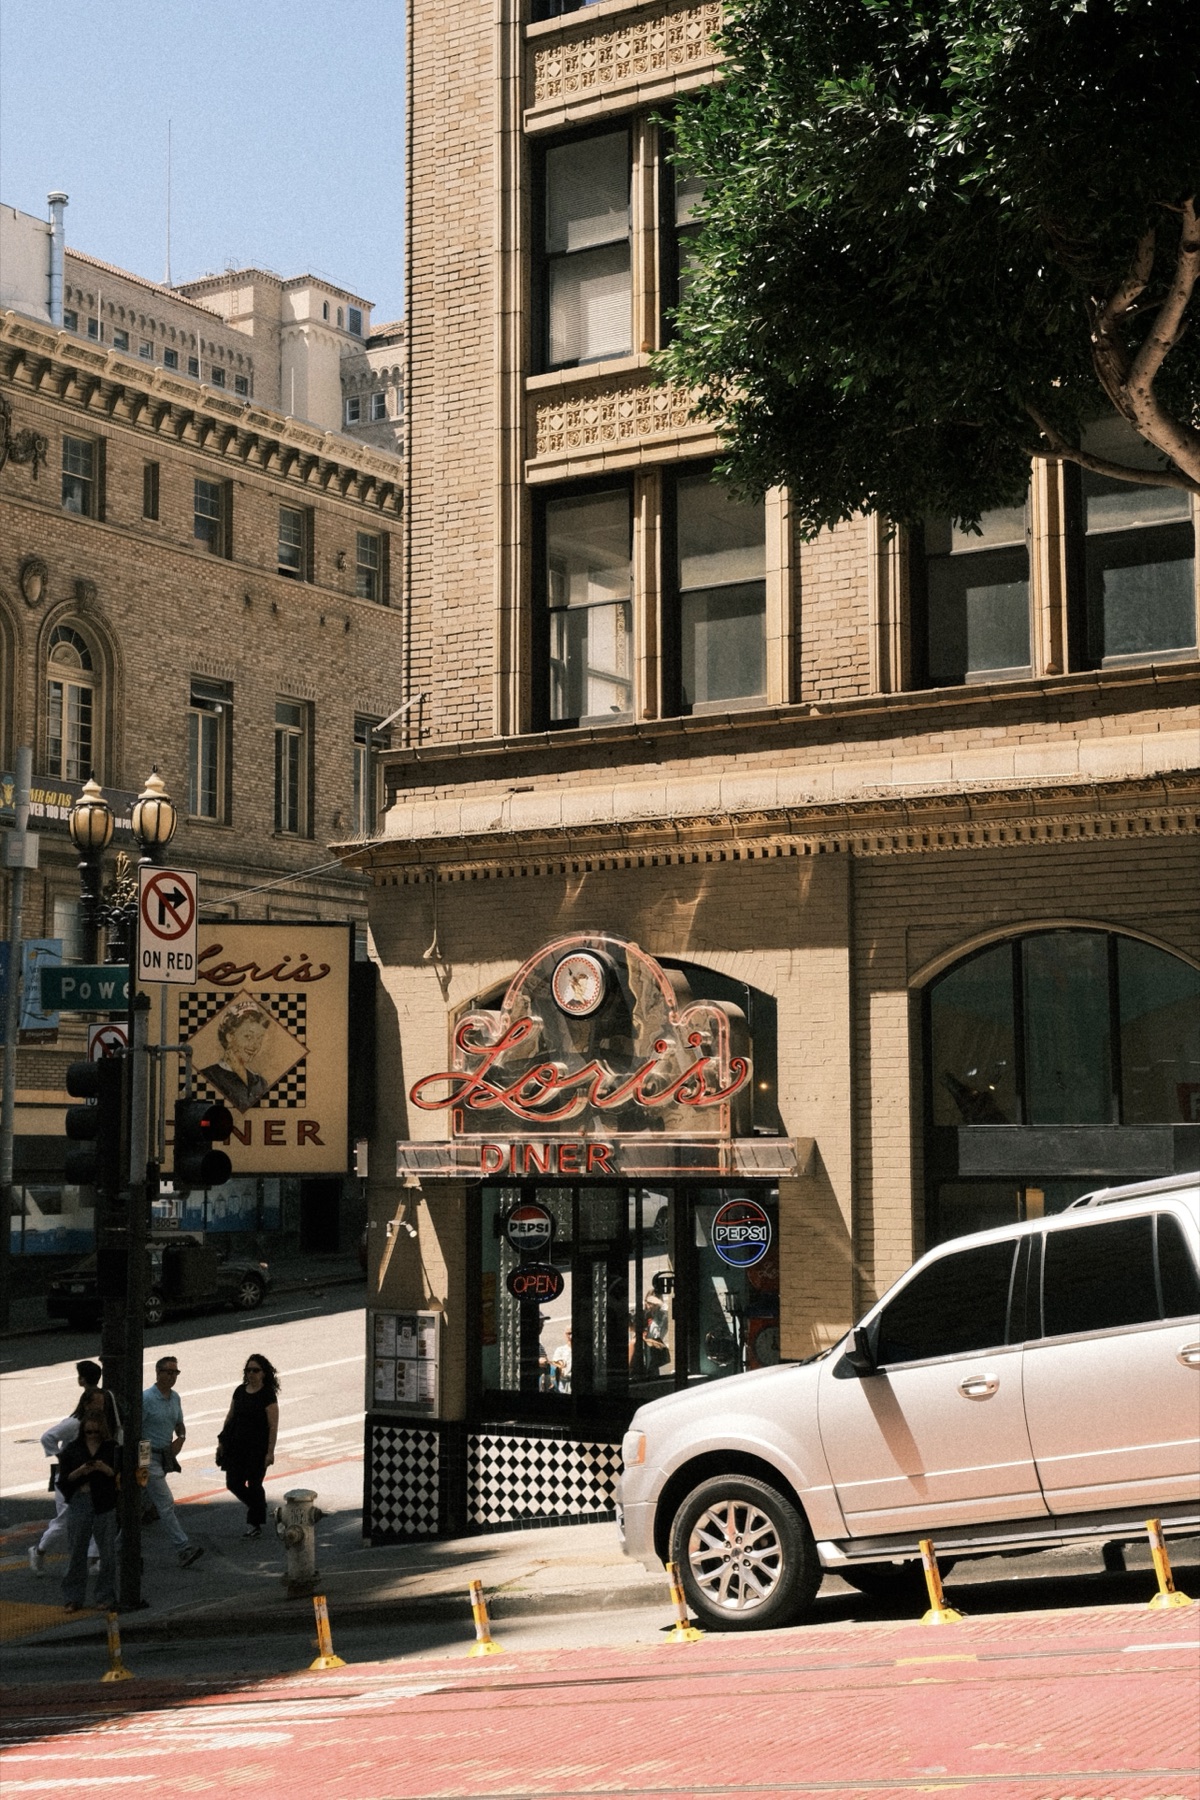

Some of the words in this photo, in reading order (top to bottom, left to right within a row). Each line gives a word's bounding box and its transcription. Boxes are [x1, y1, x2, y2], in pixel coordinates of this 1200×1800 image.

[29, 802, 44, 817] VER
[46, 804, 59, 819] 100
[143, 950, 161, 968] ON
[167, 952, 193, 970] RED
[61, 977, 130, 999] Powe
[480, 1143, 615, 1174] DINER
[509, 1222, 549, 1233] PEPSI
[716, 1226, 767, 1241] PEPSI
[513, 1275, 558, 1294] OPEN
